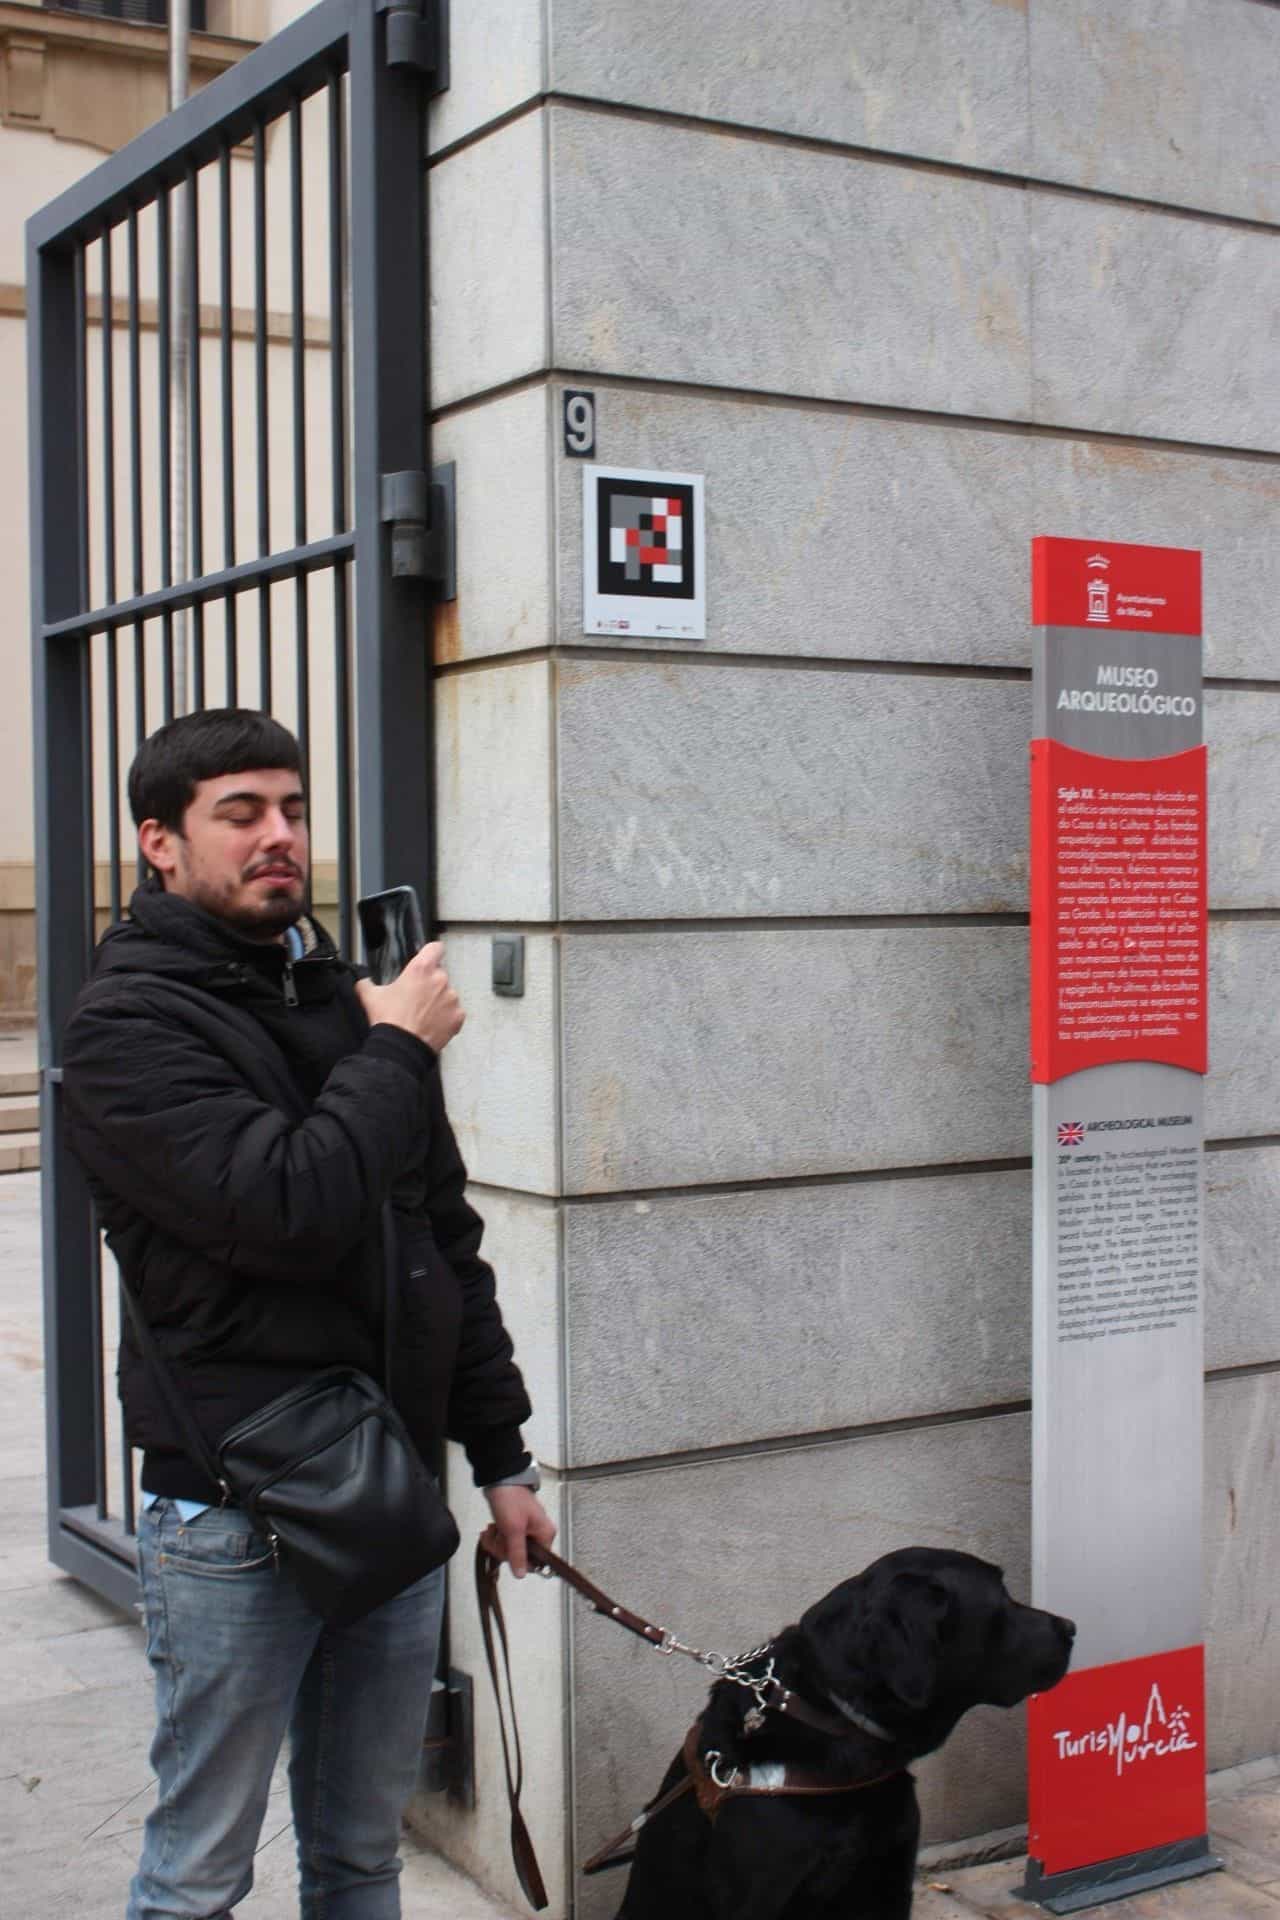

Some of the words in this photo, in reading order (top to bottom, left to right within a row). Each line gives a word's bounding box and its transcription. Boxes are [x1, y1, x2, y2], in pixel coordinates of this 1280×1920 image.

[566, 395, 593, 451] 9
[1097, 665, 1158, 688] MUSEO
[1057, 689, 1196, 716] ARQUEOLÓGICO
